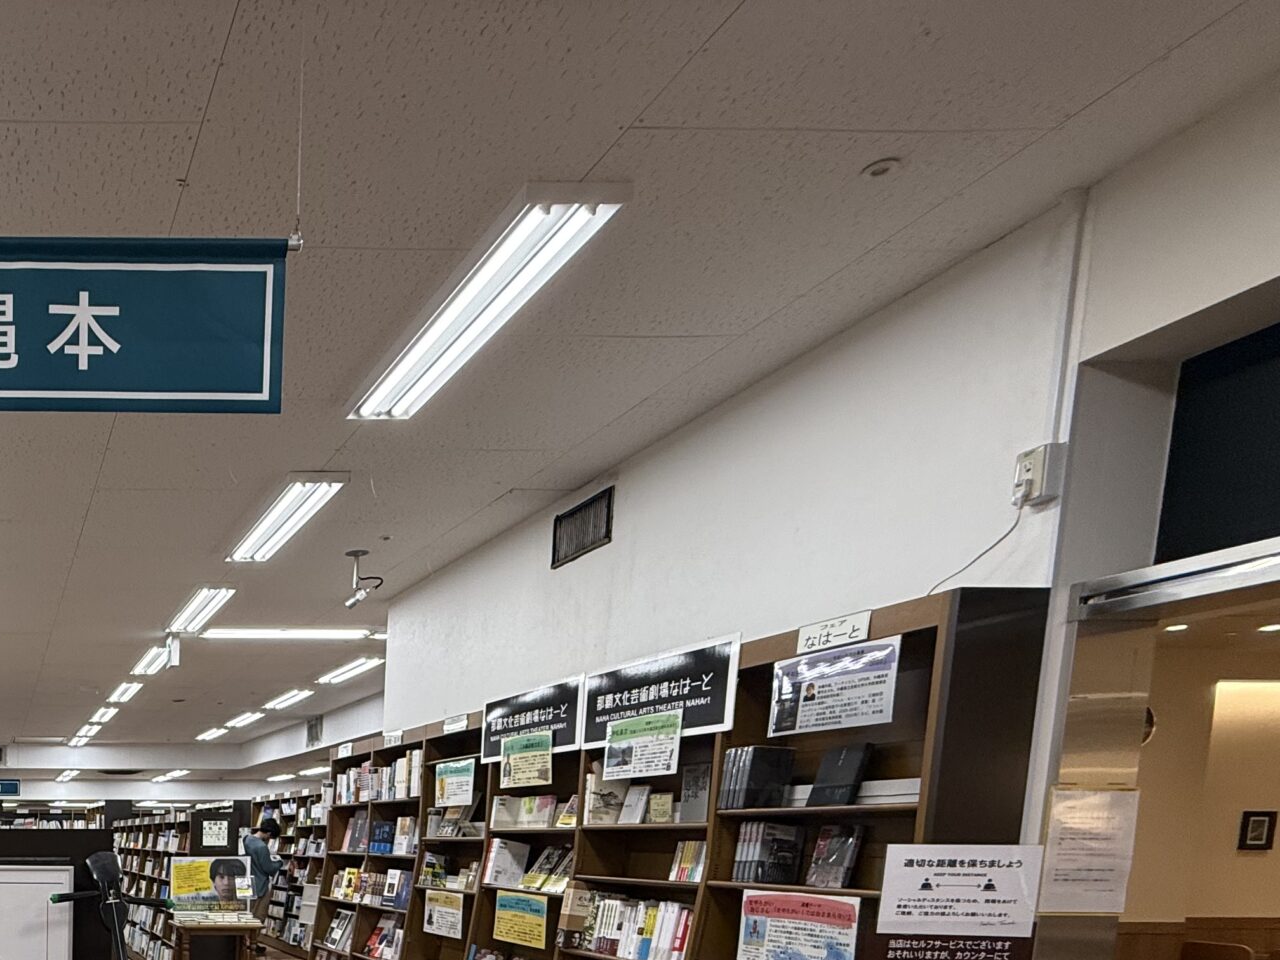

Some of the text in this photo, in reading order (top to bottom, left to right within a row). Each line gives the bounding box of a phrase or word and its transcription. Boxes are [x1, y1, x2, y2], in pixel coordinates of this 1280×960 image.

[804, 625, 861, 649] なはーと
[596, 672, 714, 711] 那覇文化芸術劇場なはーと
[610, 708, 637, 720] CULTURAL
[639, 705, 654, 715] ARTS
[655, 701, 684, 712] THEATER
[686, 696, 711, 707] NAHArt
[904, 858, 1023, 868] 適切な距離を保ちましょう
[888, 939, 1011, 950] 当店はセルフサービスでございます
[887, 950, 1010, 960] おそれいりますが、カウンターにて
